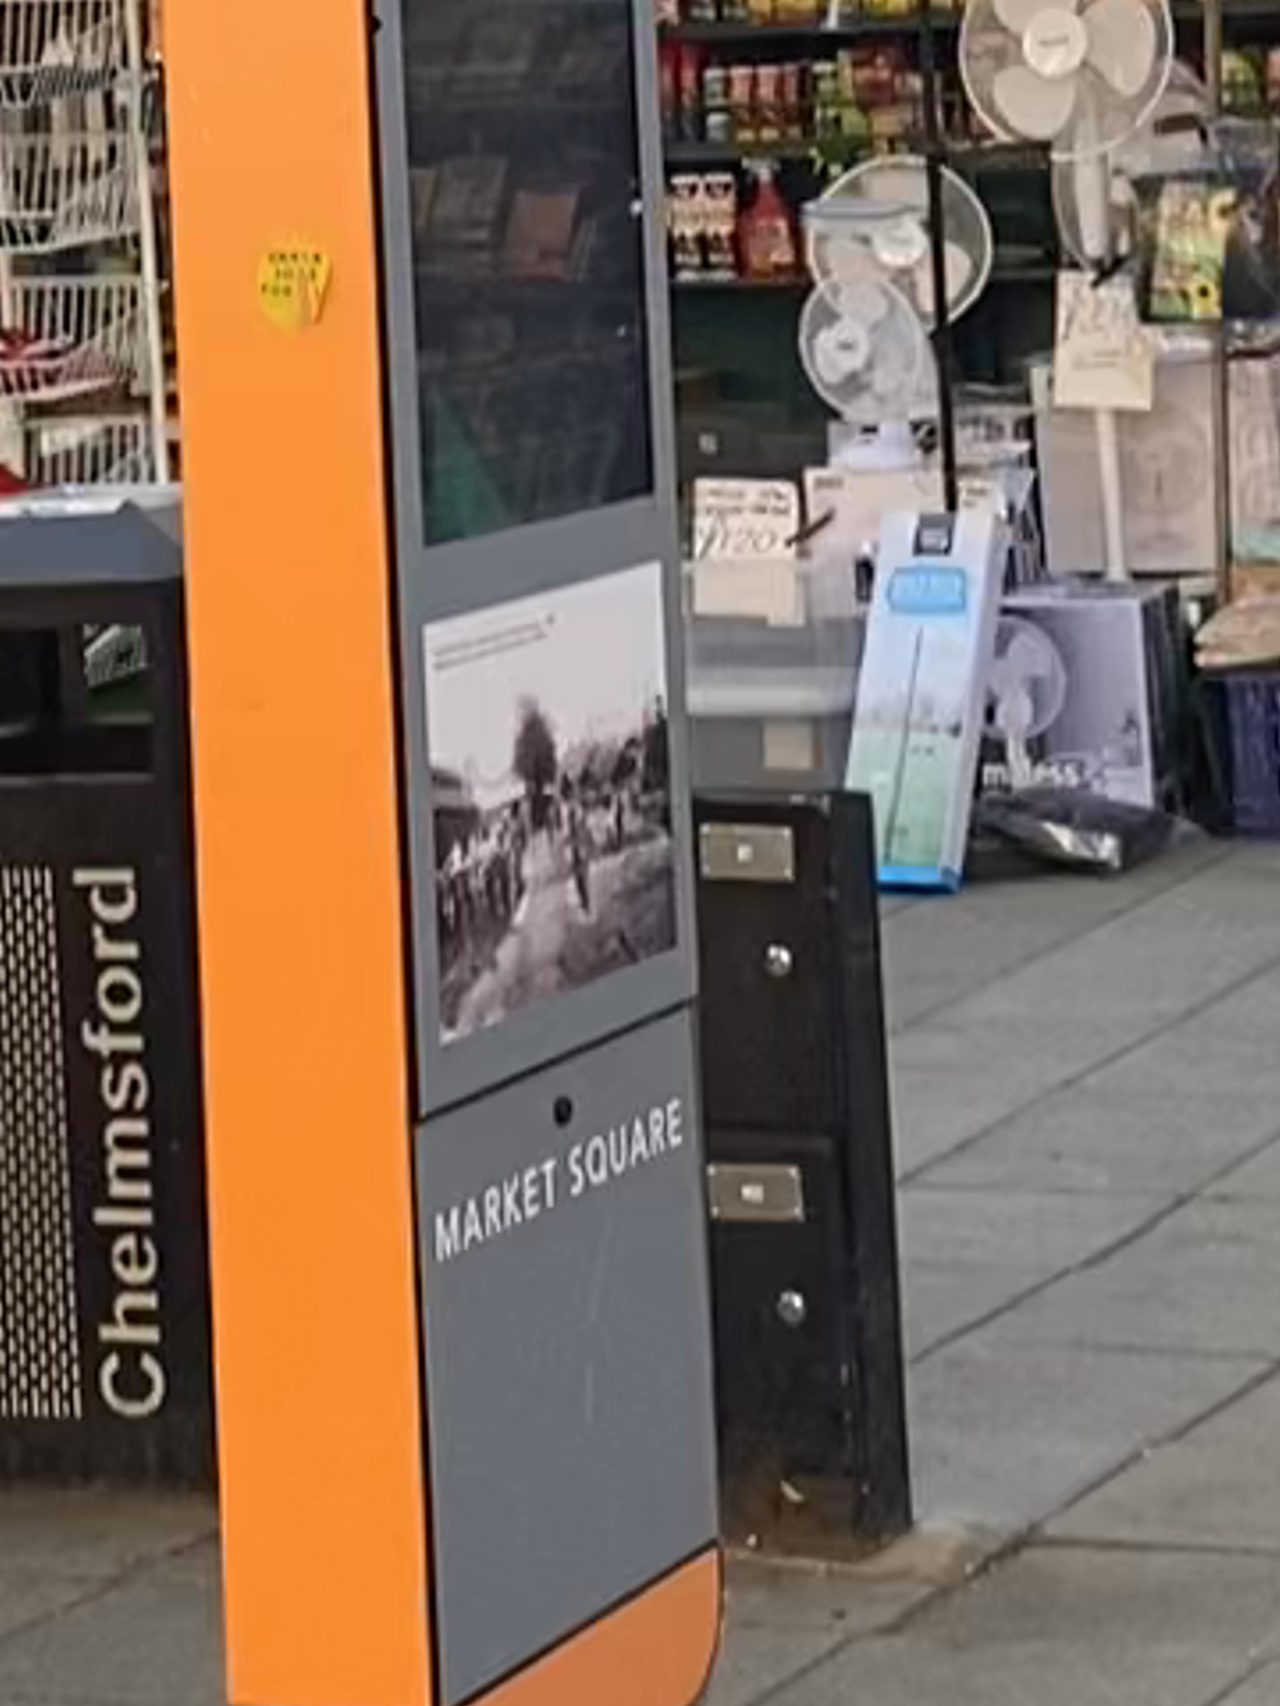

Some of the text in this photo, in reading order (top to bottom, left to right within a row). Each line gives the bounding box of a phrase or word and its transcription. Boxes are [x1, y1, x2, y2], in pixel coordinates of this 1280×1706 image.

[72, 866, 166, 1419] Chelmsford
[434, 1097, 683, 1263] MARKET SQUARE
